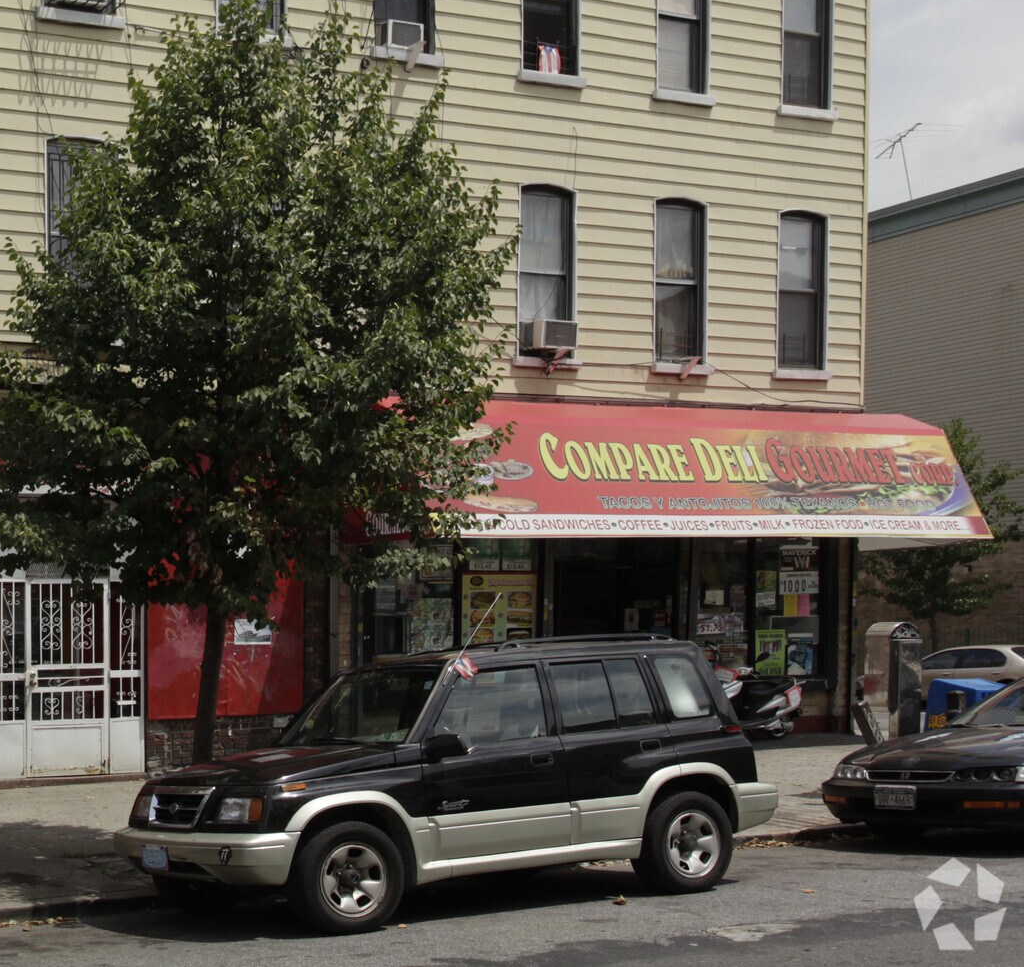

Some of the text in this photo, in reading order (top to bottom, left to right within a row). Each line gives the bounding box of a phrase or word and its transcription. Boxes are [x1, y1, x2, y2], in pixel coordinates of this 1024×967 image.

[539, 432, 695, 482] COMPARE
[689, 437, 769, 483] DELI
[765, 438, 906, 484] GOURMET
[597, 496, 653, 510] TACOS
[652, 497, 665, 509] Y
[668, 496, 752, 511] ANTOJITOS
[755, 497, 791, 510] 100%
[866, 498, 893, 510] HOT
[898, 499, 937, 511] FOOD
[497, 519, 531, 530] COLD
[533, 519, 611, 531] SANDWICHES
[618, 519, 663, 531] COFFEE
[670, 519, 709, 531] JUICES
[716, 520, 754, 531] FRUITS
[759, 520, 784, 531] MILK
[793, 519, 834, 531] FROZEN
[836, 520, 864, 531] FOOD
[869, 520, 887, 531] ICE
[888, 520, 923, 531] CREAM
[924, 521, 931, 531] &
